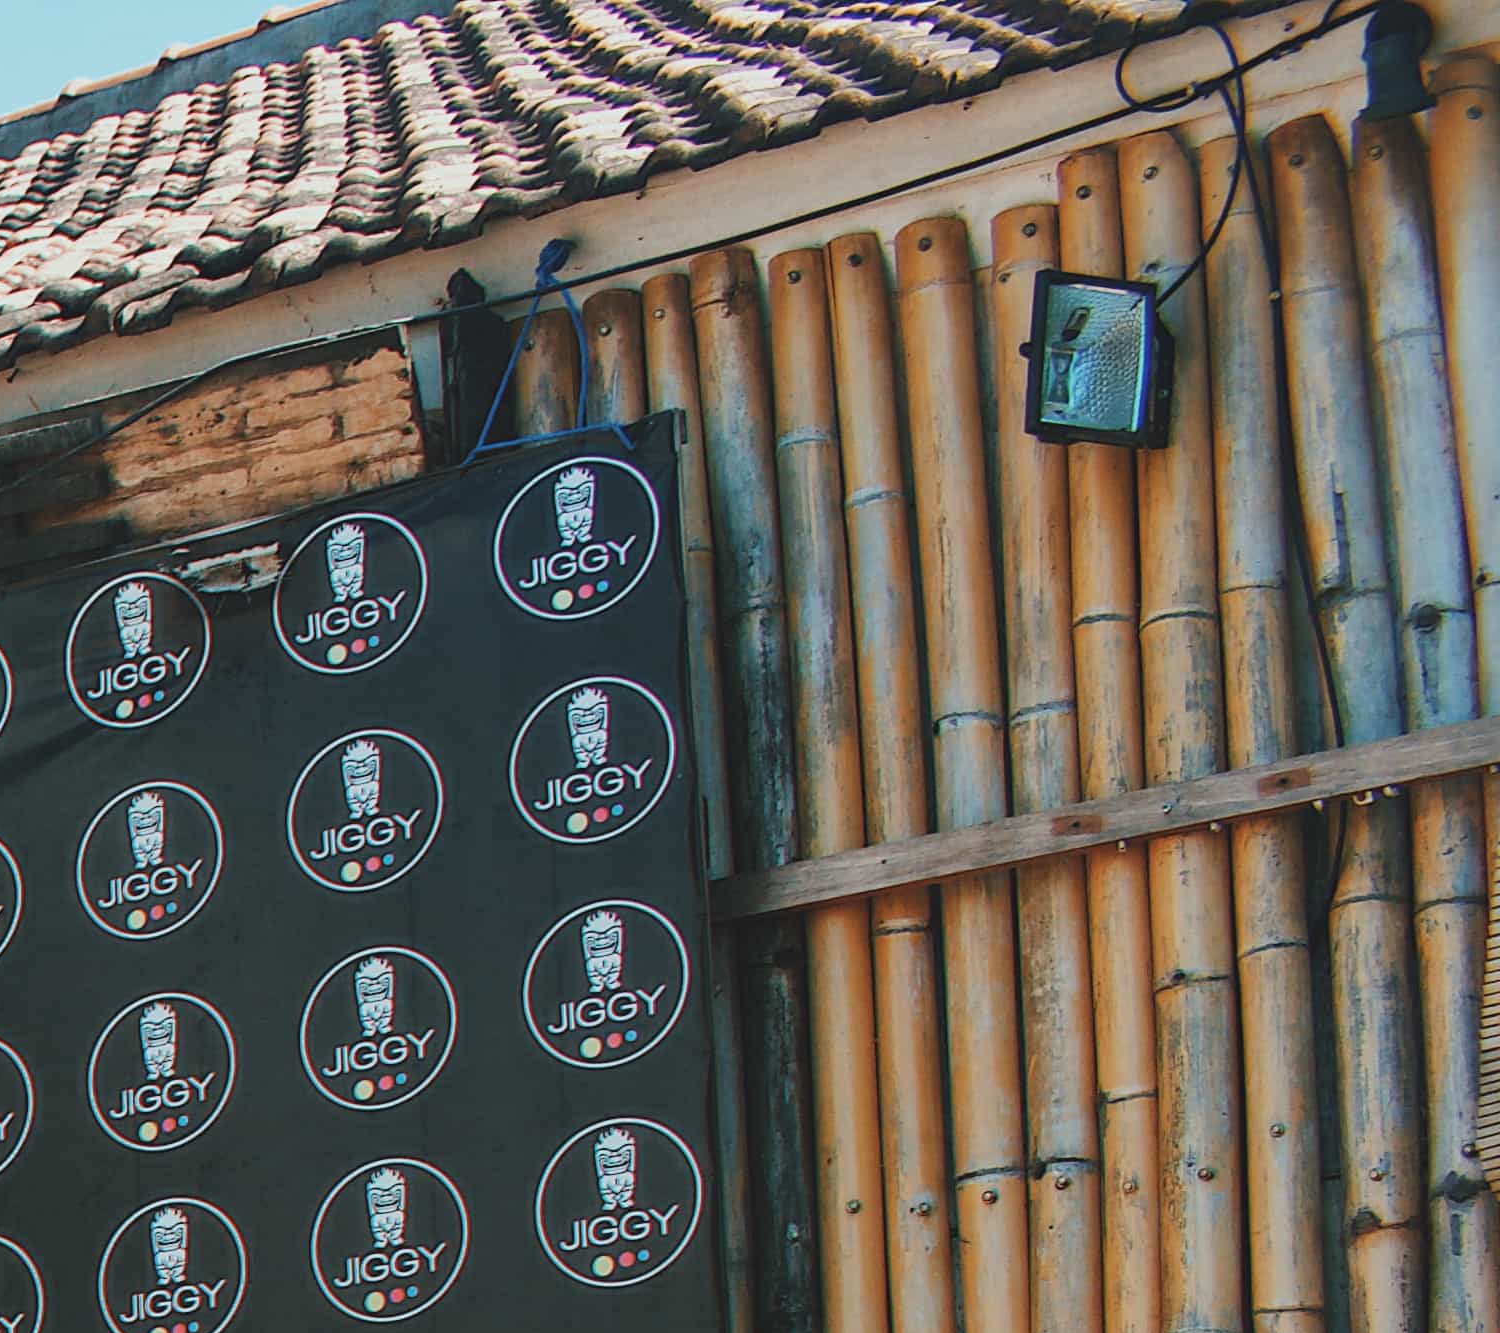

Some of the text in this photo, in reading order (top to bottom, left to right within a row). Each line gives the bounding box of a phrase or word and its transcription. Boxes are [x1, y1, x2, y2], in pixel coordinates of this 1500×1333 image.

[519, 535, 636, 588] JIGGY
[295, 591, 406, 643] JIGGY
[87, 647, 190, 698] JIGGY
[534, 759, 652, 810] JIGGY
[310, 809, 421, 859] JIGGY
[98, 859, 202, 908] JIGGY
[560, 1205, 679, 1250] JIGGY
[334, 1242, 446, 1287] JIGGY
[120, 1279, 226, 1322] JIGGY
